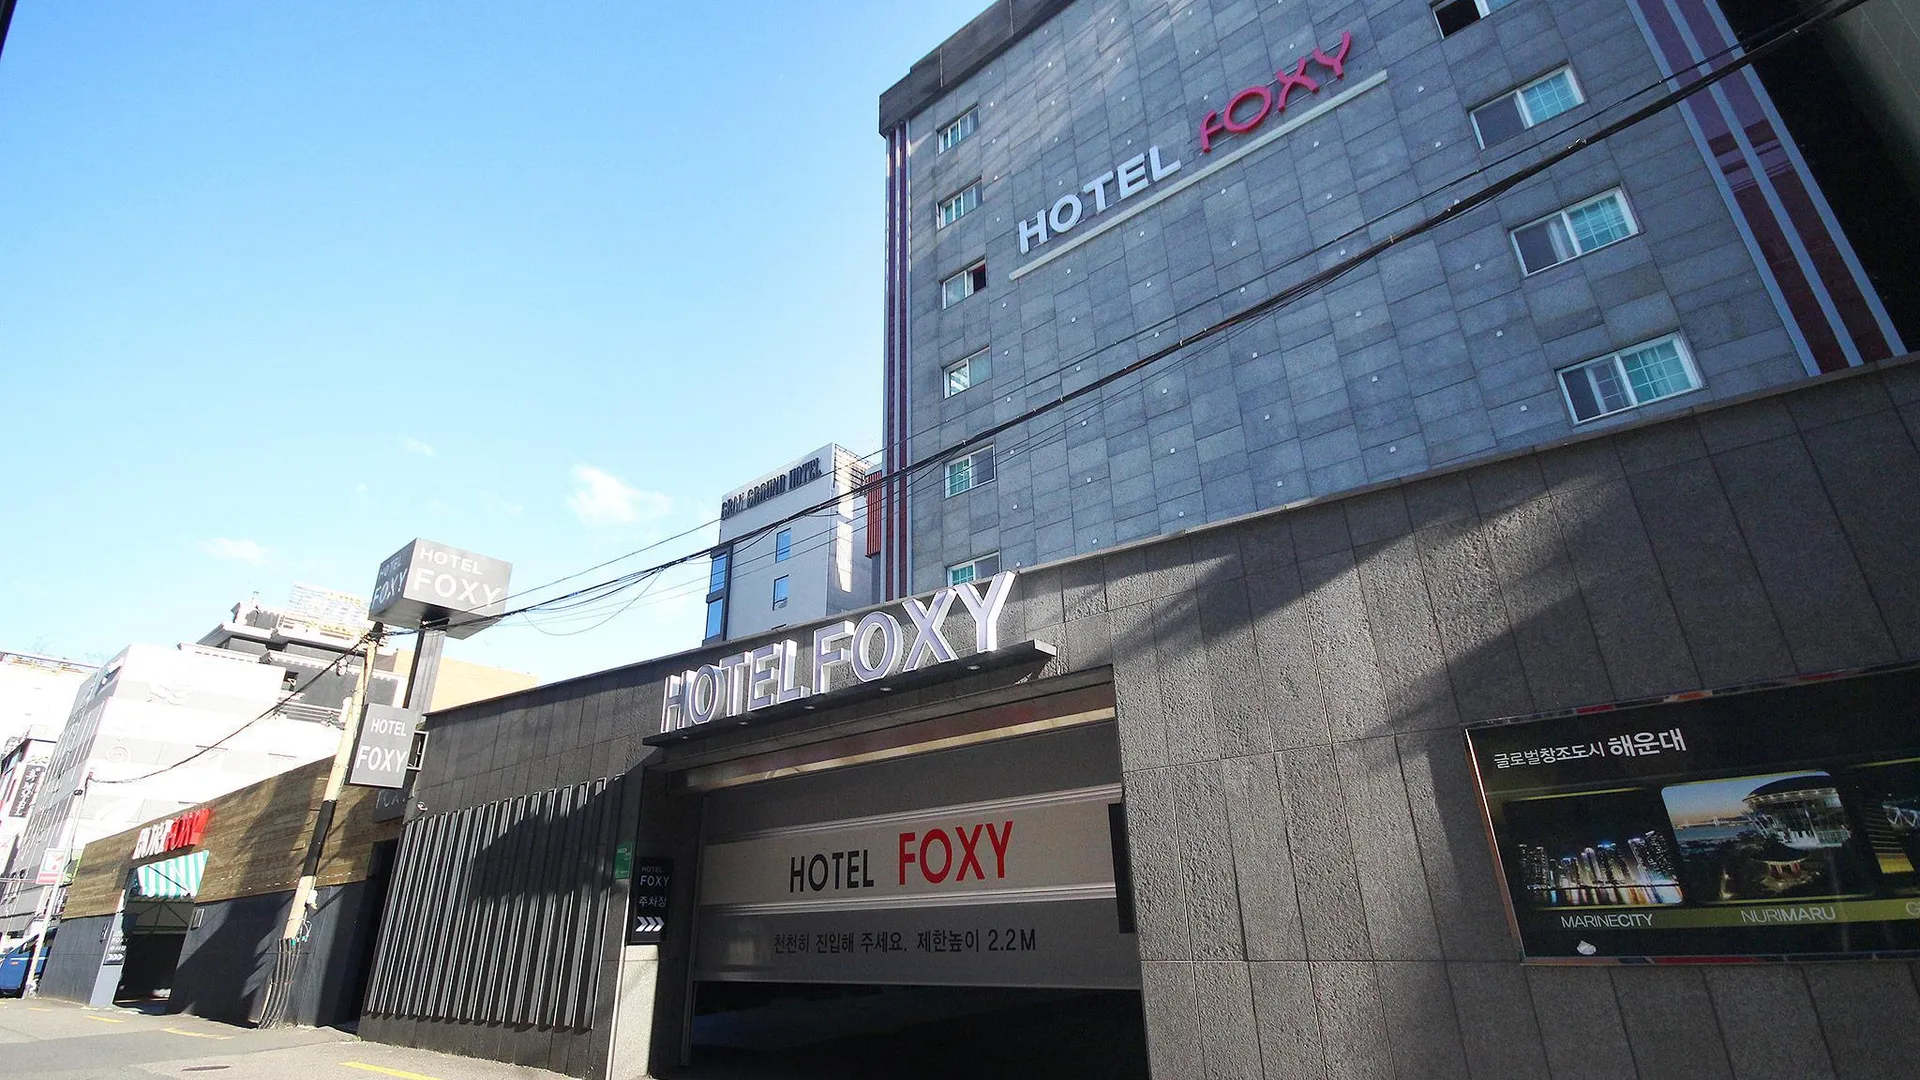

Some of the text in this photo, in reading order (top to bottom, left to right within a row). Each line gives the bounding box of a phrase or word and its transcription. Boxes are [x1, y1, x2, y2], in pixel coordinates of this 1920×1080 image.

[1018, 31, 1352, 254] HOTEL FOXY
[746, 474, 788, 508] GROUND
[788, 457, 823, 490] HOTEL
[420, 547, 484, 575] HOTEL
[371, 568, 408, 609] FOXY
[413, 567, 502, 609] FOXY
[660, 570, 1016, 733] HOTEL FOXY
[370, 717, 407, 737] HOTEL
[355, 744, 409, 774] FOXY
[1493, 727, 1687, 770] 글로벌창조도시 해운대
[789, 820, 1014, 893] HOTEL FOXY
[640, 875, 670, 887] FOXY
[639, 895, 668, 908] 주차장
[1740, 906, 1836, 923] NURIMARU
[1560, 913, 1653, 928] MARINECITY
[773, 932, 810, 953] 천천히
[815, 931, 855, 953] 진입해
[859, 931, 908, 953] 주세요.
[916, 929, 980, 953] 제한높이
